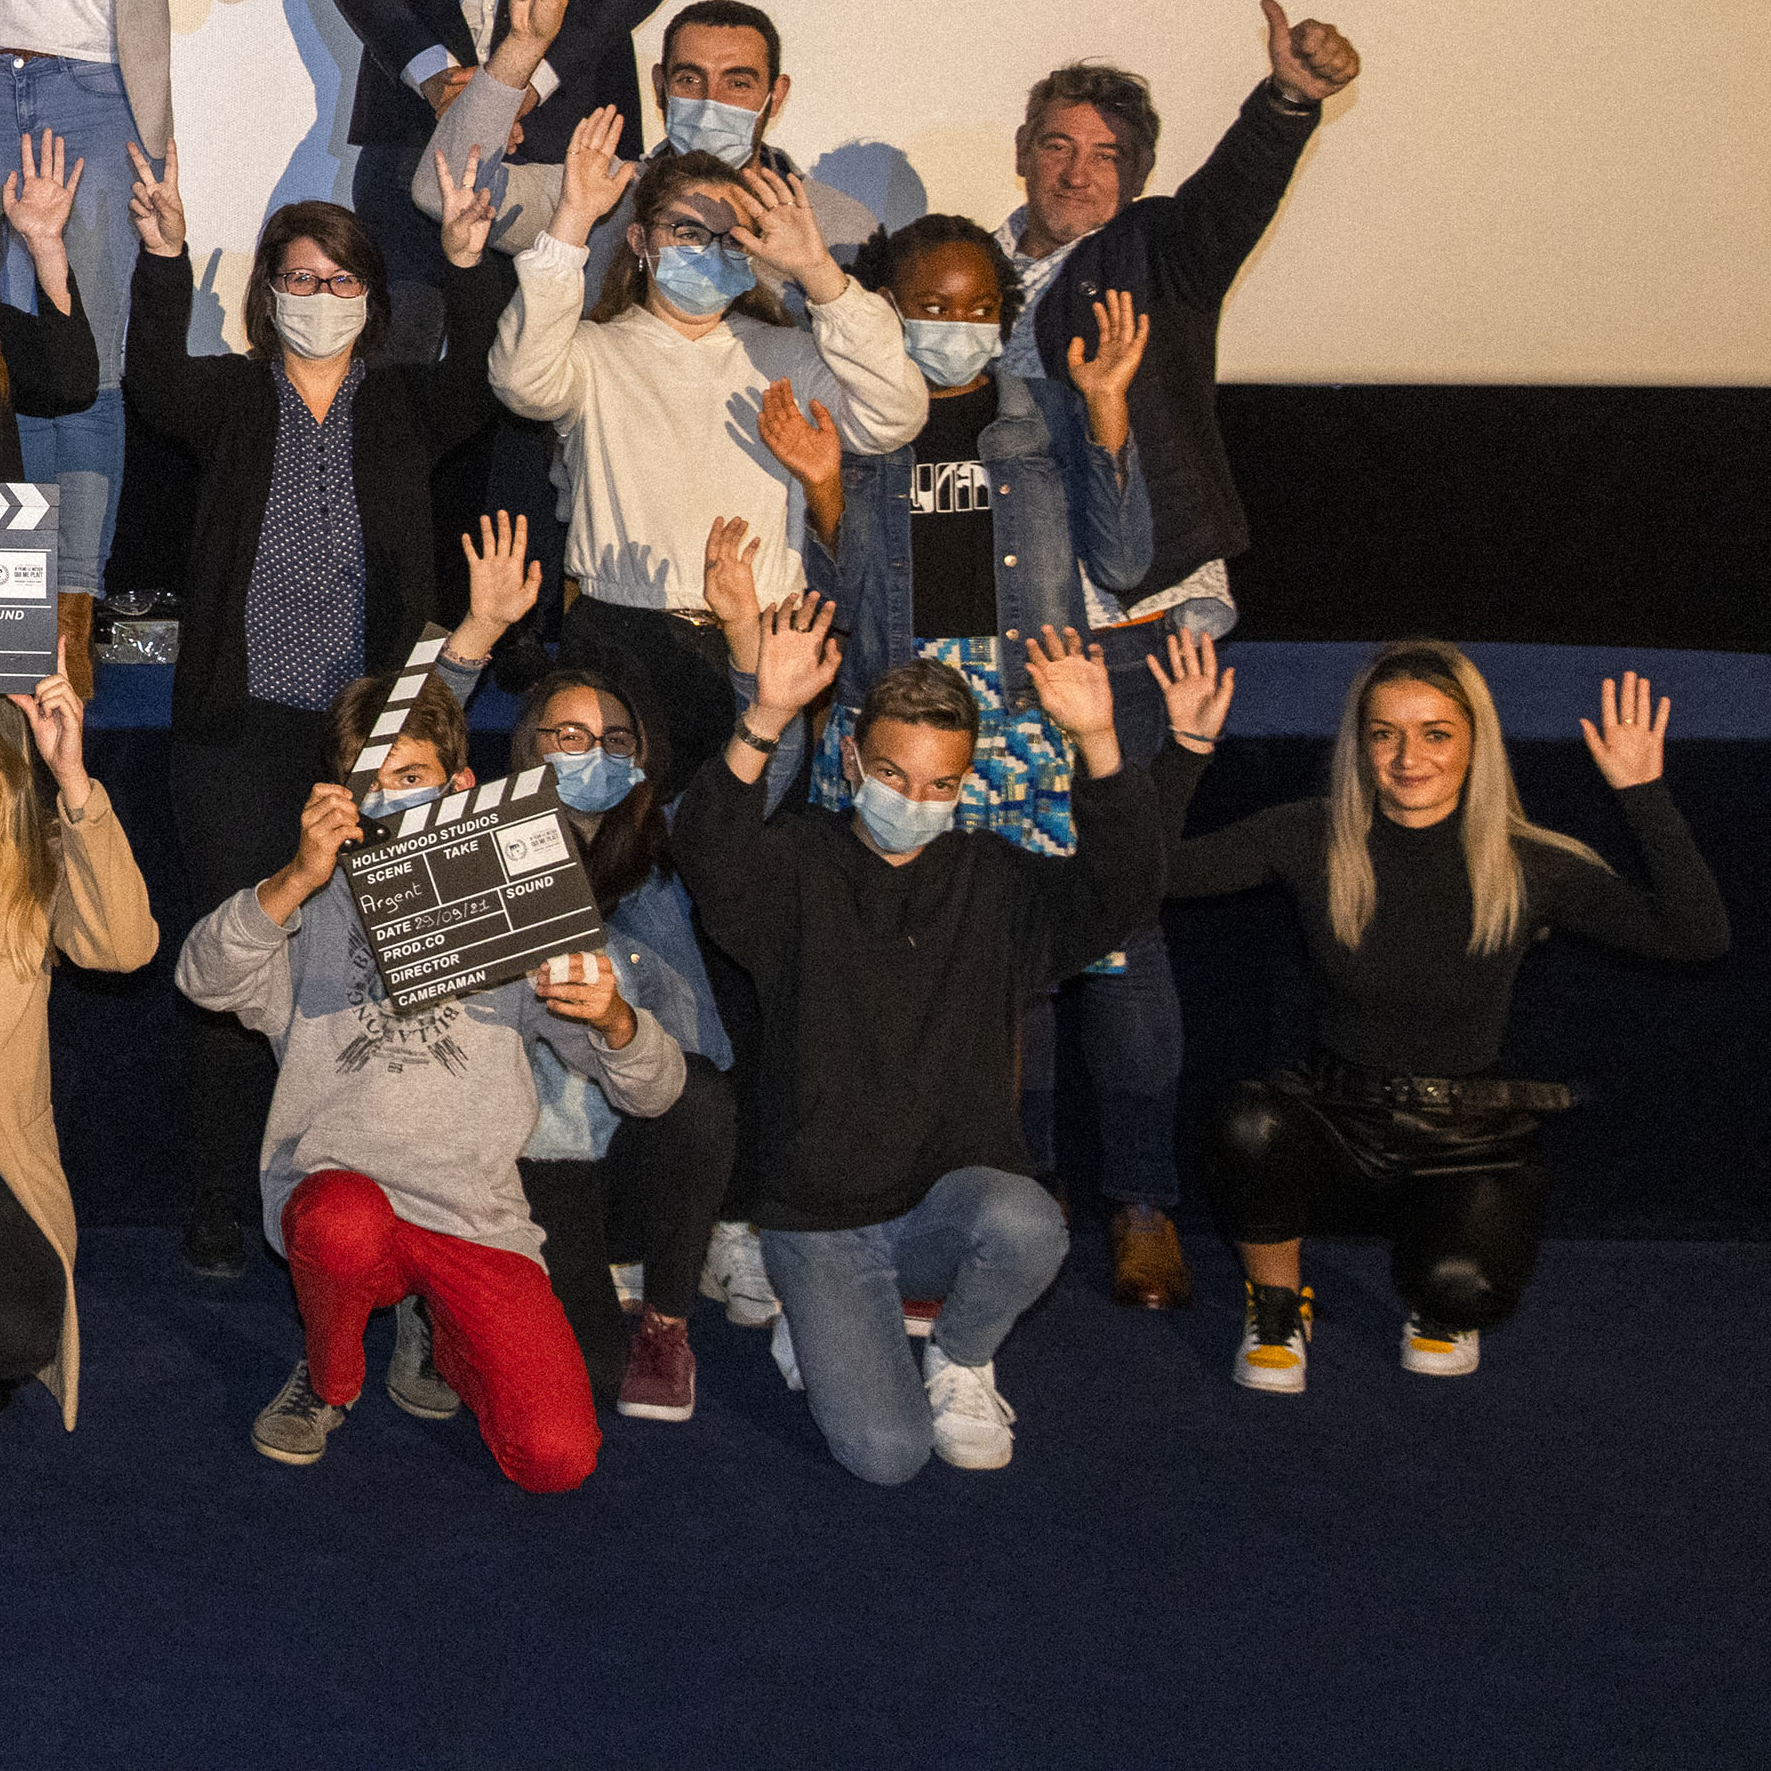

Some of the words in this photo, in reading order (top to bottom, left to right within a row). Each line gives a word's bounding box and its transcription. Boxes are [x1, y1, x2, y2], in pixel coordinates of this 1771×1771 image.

[352, 833, 438, 870] HOLLYWOOD
[439, 813, 499, 840] STUDIOS
[443, 840, 480, 860] TAKE
[366, 862, 414, 884] SCENE
[359, 883, 423, 916] Argent
[506, 876, 555, 900] SOUND
[413, 899, 491, 929] 29/09/21
[376, 921, 412, 941] DATE
[383, 933, 446, 962] PROD.CO
[390, 953, 460, 984] DIRECTOR
[398, 970, 487, 1006] CAMERAMAN
